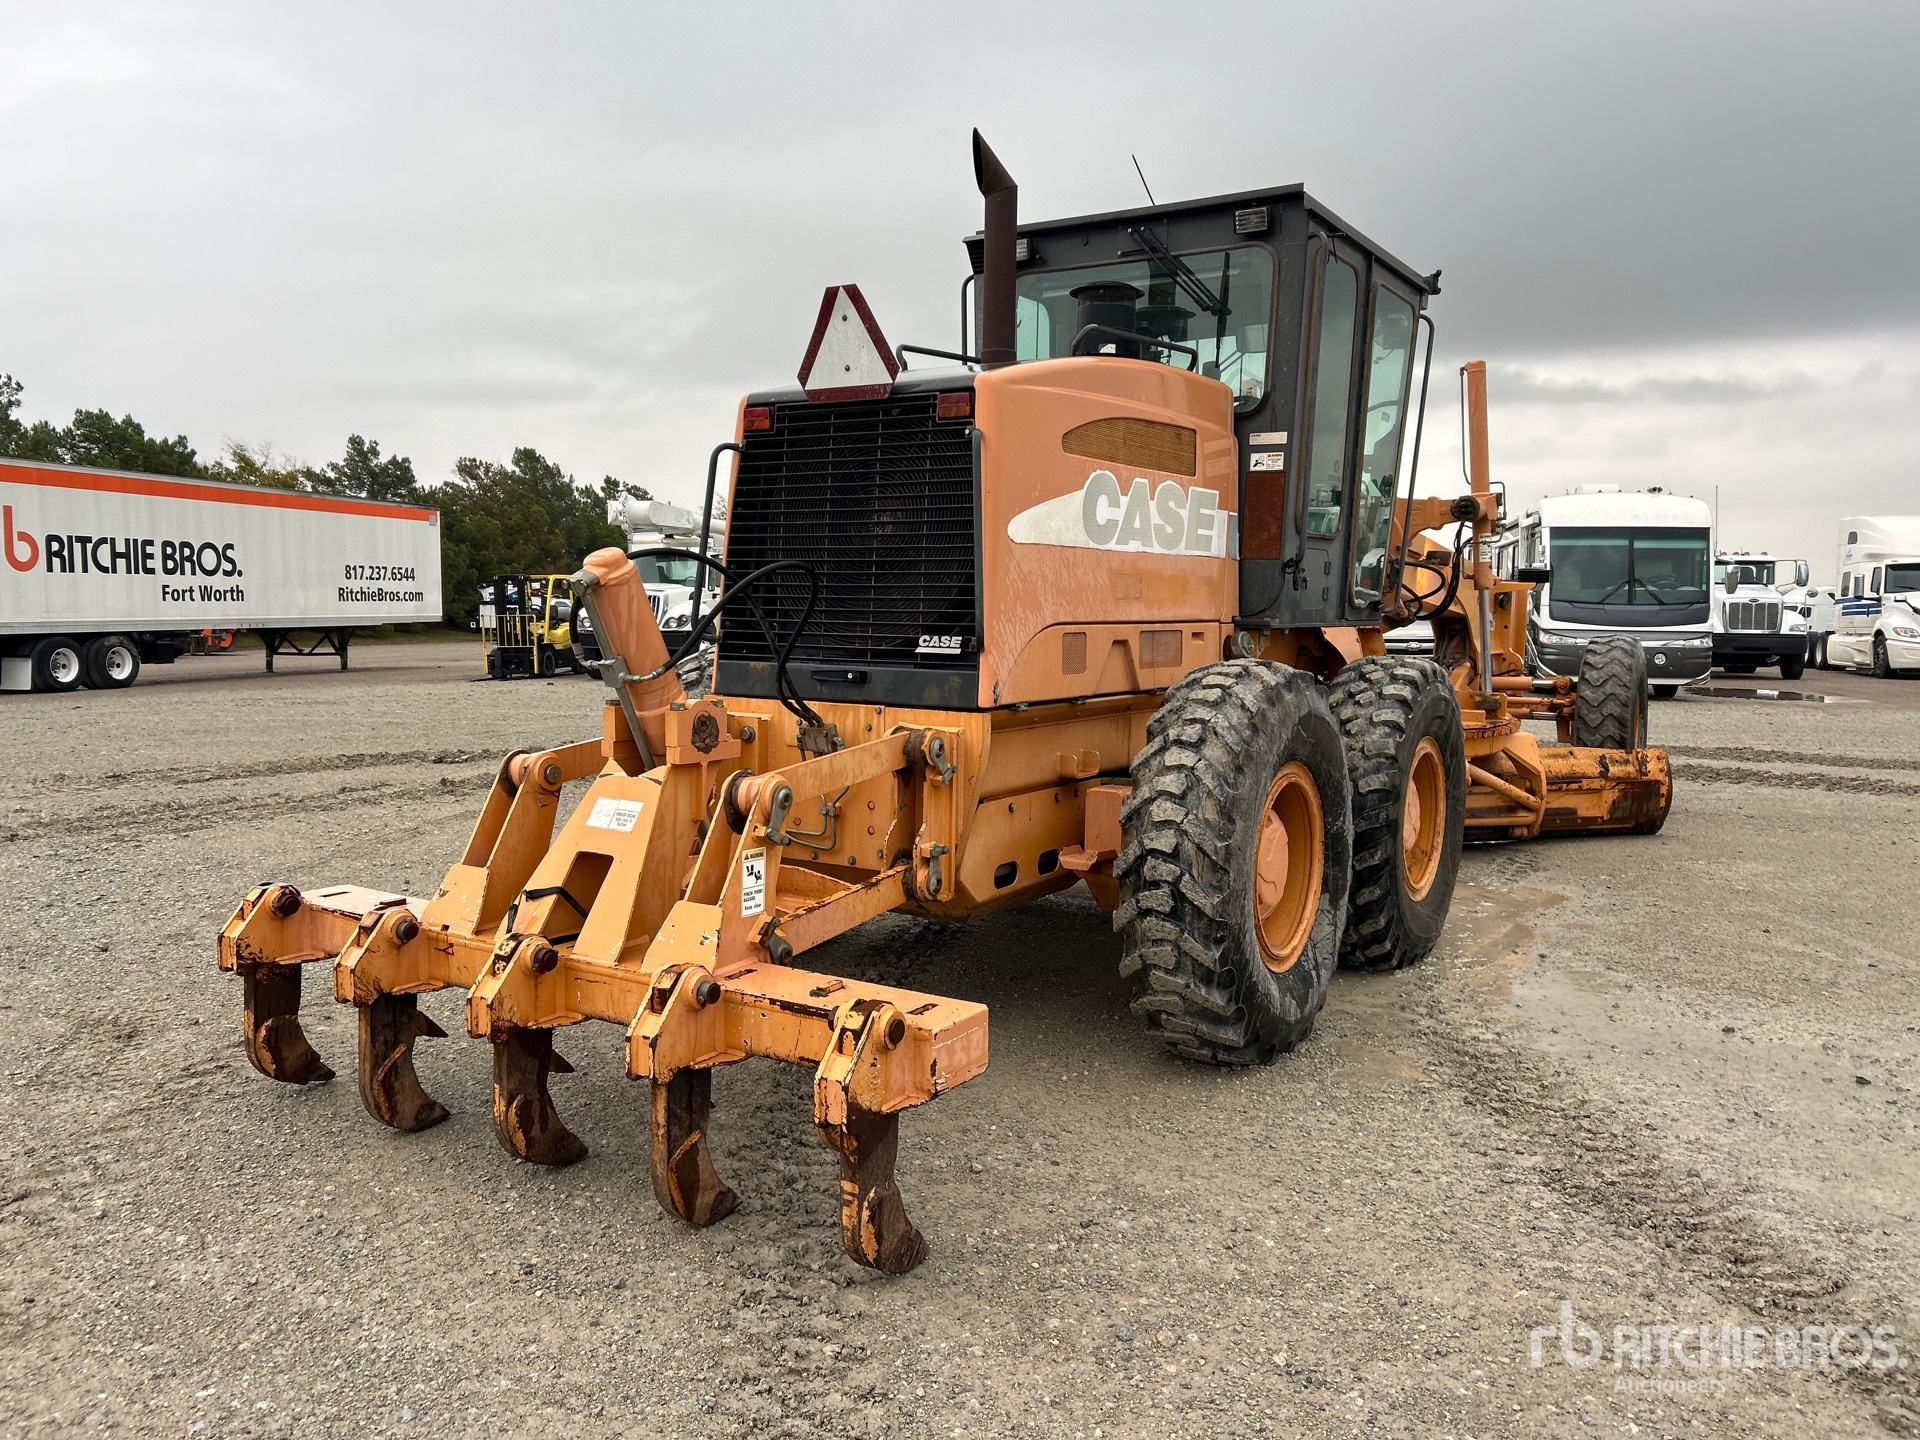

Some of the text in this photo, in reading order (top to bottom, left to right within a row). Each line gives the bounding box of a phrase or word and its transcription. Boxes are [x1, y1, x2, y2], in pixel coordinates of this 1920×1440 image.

[1082, 471, 1218, 553] CASE
[45, 534, 243, 577] RITCHIE BROS.
[344, 564, 415, 581] 817.237.6544
[162, 584, 244, 602] Fort Worth
[338, 586, 424, 602] RitchieBros.com
[918, 634, 962, 648] CASE
